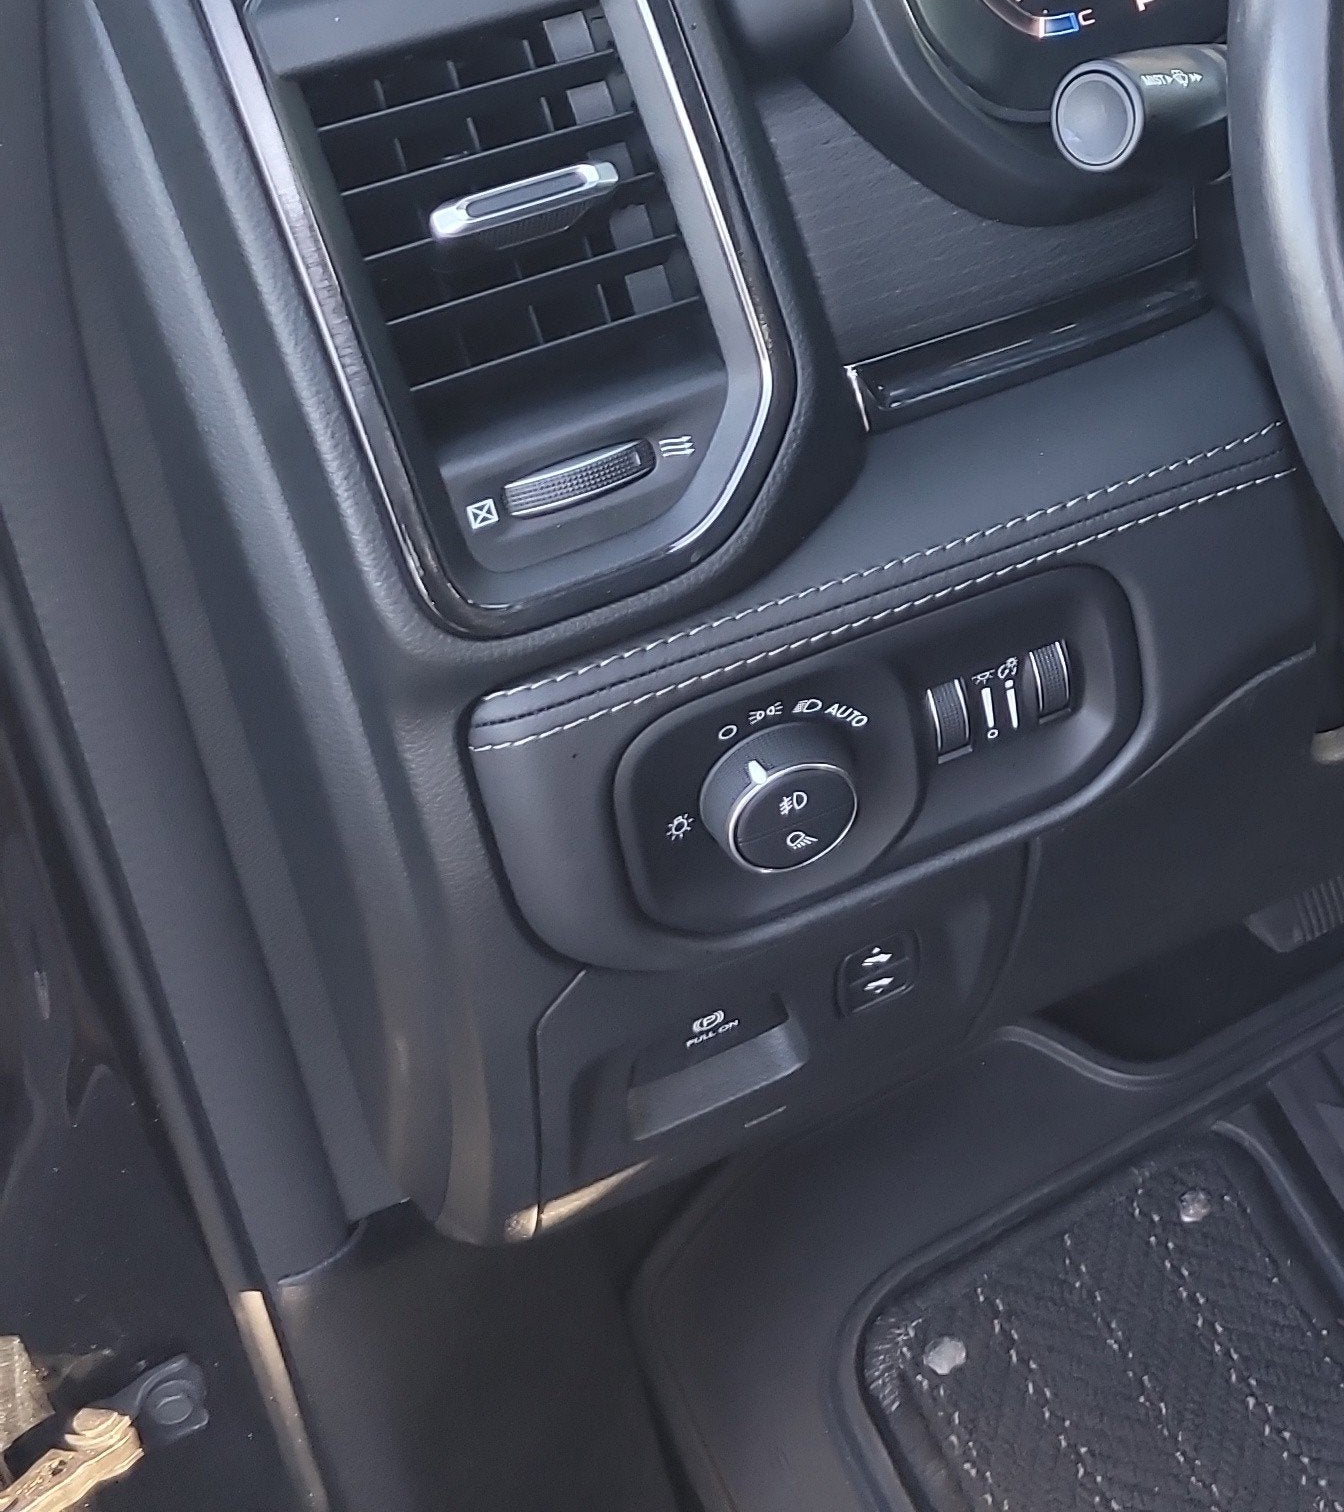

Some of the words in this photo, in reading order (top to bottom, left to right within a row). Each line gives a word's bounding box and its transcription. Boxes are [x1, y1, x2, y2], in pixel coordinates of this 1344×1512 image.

[1077, 9, 1096, 27] C
[825, 704, 869, 727] AUTO
[685, 1029, 716, 1049] PULL
[717, 1018, 740, 1034] ON
